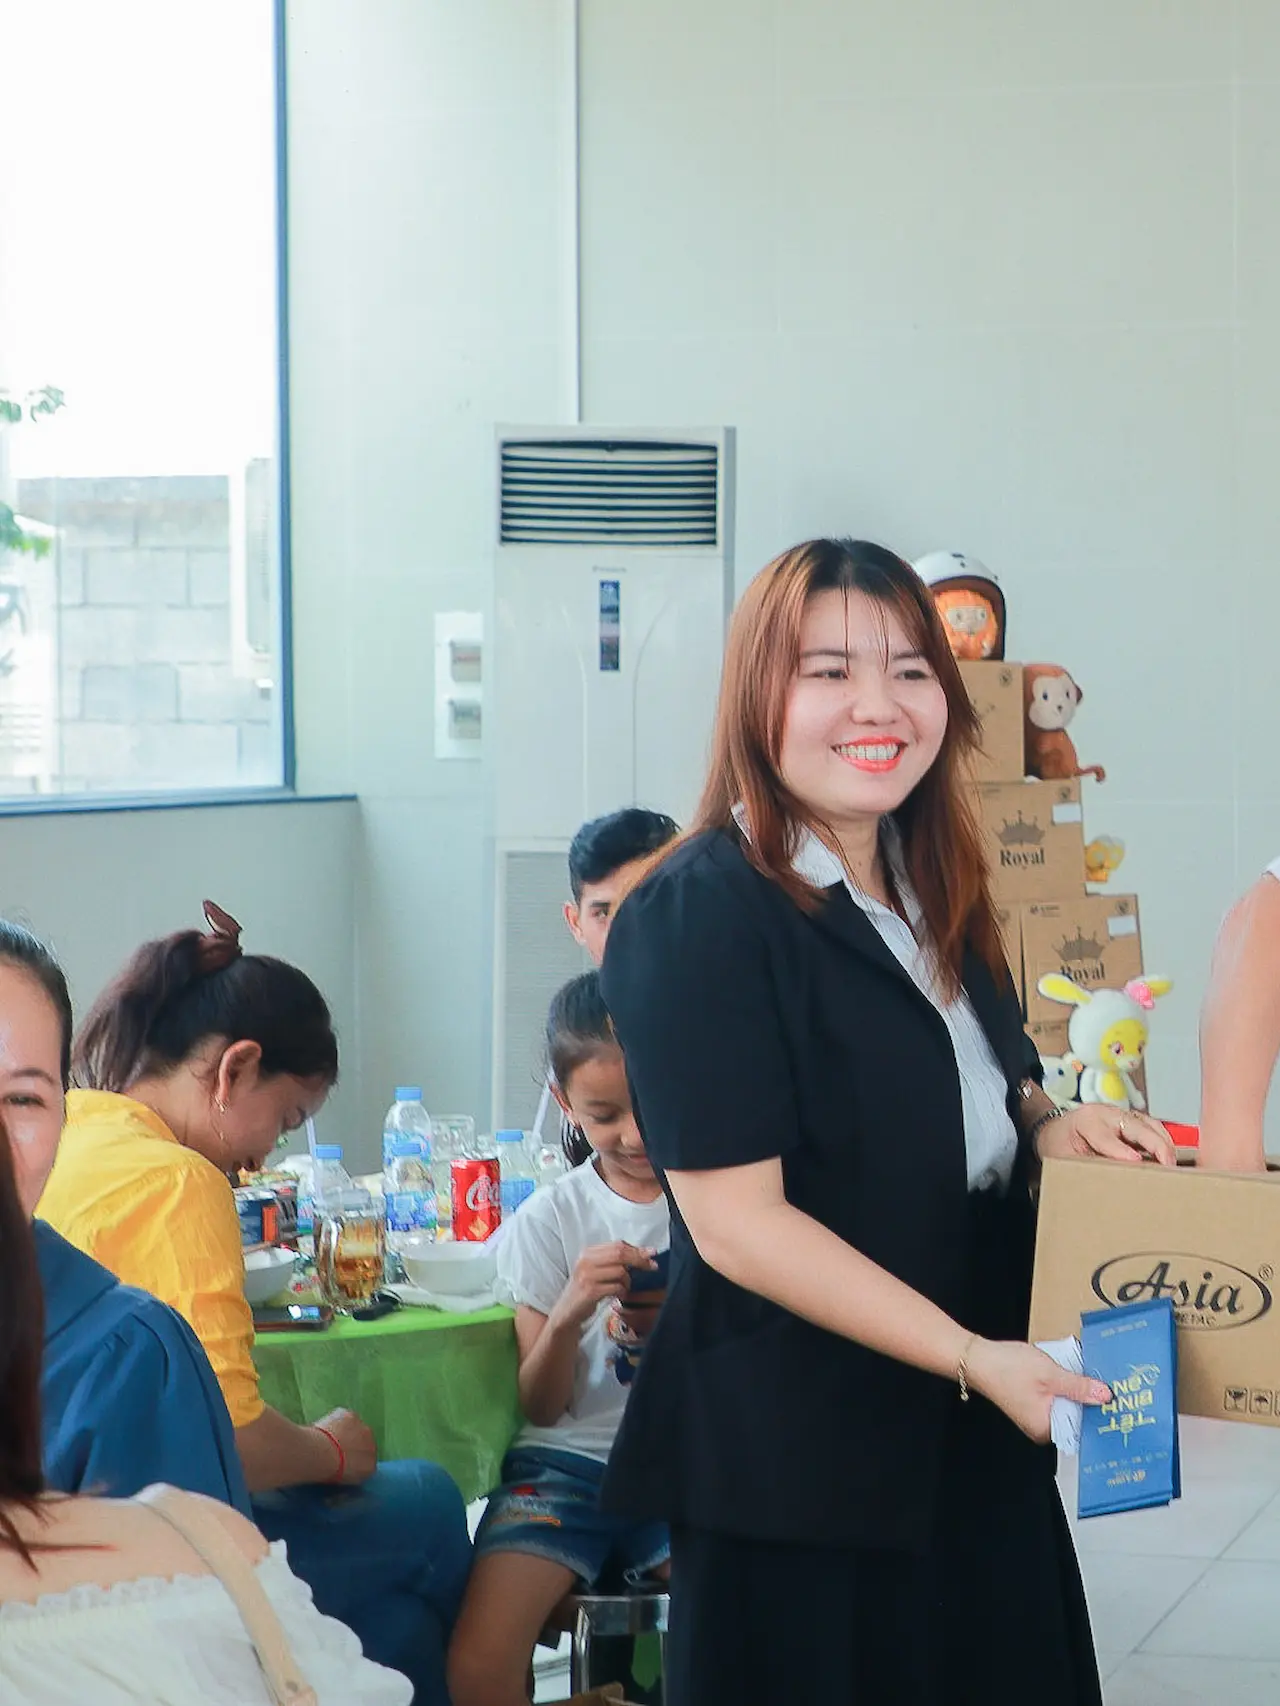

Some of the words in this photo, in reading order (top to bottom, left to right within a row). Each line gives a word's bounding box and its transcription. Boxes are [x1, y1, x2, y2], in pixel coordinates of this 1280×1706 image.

[1000, 848, 1046, 869] Royal
[1060, 962, 1106, 983] Royal
[1117, 1261, 1244, 1315] Asia
